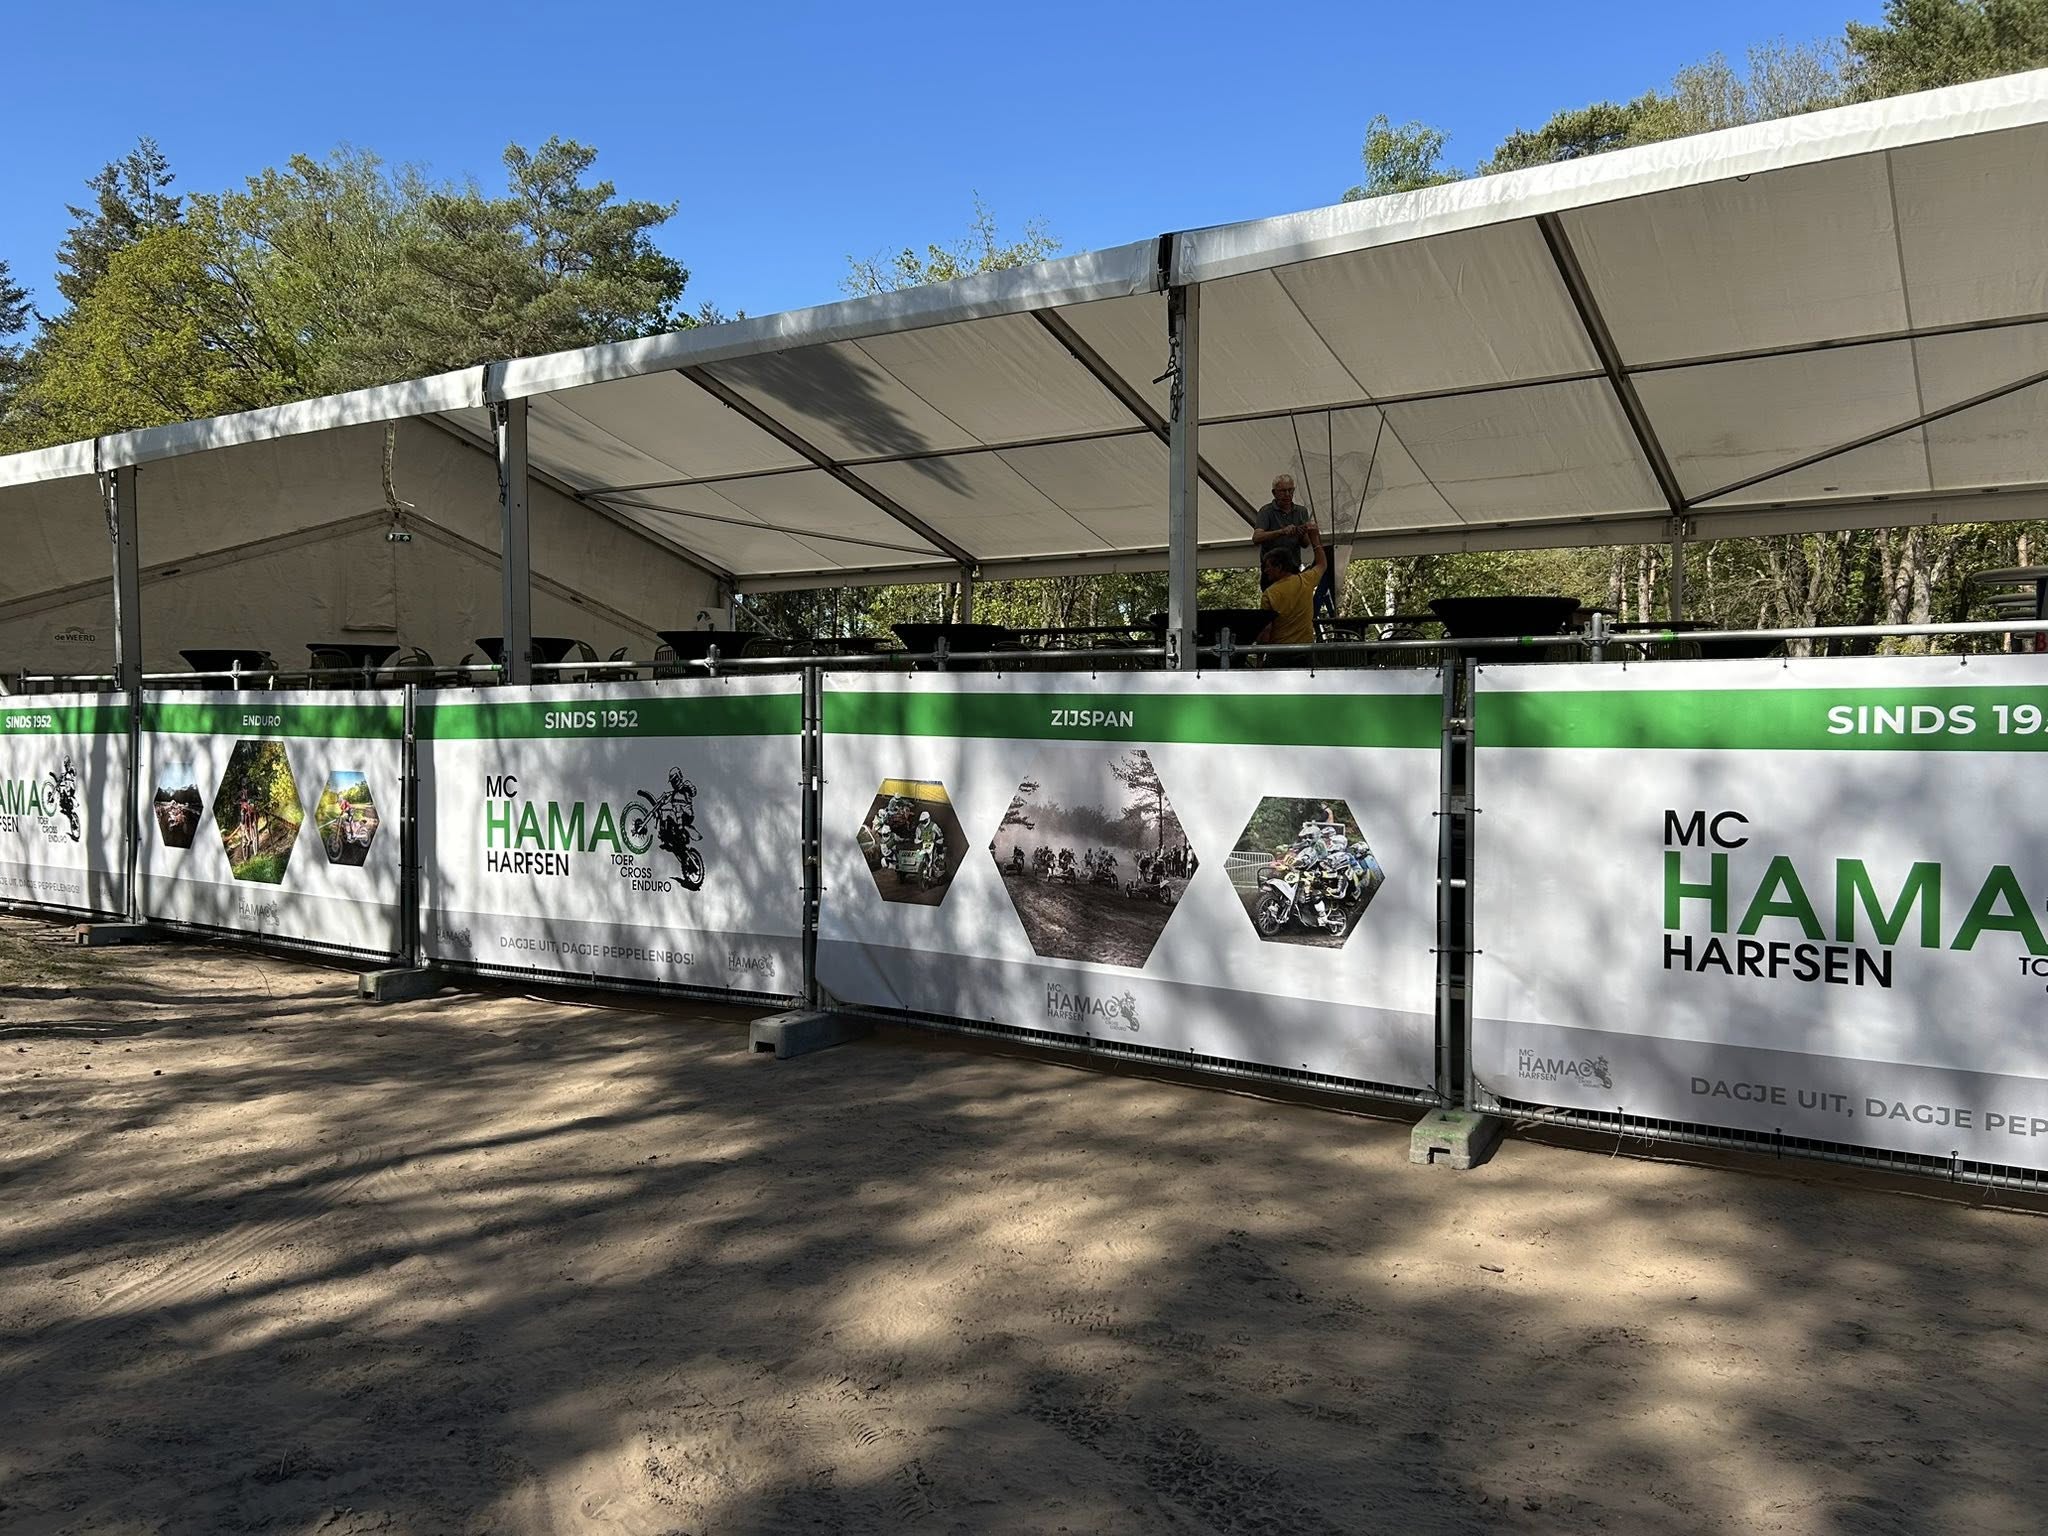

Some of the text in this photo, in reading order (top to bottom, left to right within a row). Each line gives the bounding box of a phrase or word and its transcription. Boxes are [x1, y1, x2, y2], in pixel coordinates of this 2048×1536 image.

[6, 715, 52, 729] SINDS 1952
[242, 714, 281, 727] ENDURO
[545, 710, 639, 729] SINDS 1952
[1051, 710, 1134, 728] ZIJSPAN
[1826, 704, 2048, 735] SINDS 19
[486, 775, 518, 798] MC
[1664, 809, 1750, 849] MC
[487, 851, 569, 876] HARFSEN
[611, 854, 634, 866] TOER
[620, 866, 652, 878] CROSS
[632, 880, 672, 893] ENDURO
[1663, 850, 2048, 956] HAMA
[500, 936, 695, 965] DAGJE UIT, DAGJE PEPPELENBOS!
[1663, 933, 1892, 988] HARFSEN
[1047, 983, 1061, 992] MC
[1047, 1008, 1085, 1022] HARFSEN
[1518, 1048, 1534, 1057] MC
[1518, 1071, 1557, 1082] HARFSEN
[1691, 1077, 2048, 1137] DAGJE UIT, DAGJE PEP
